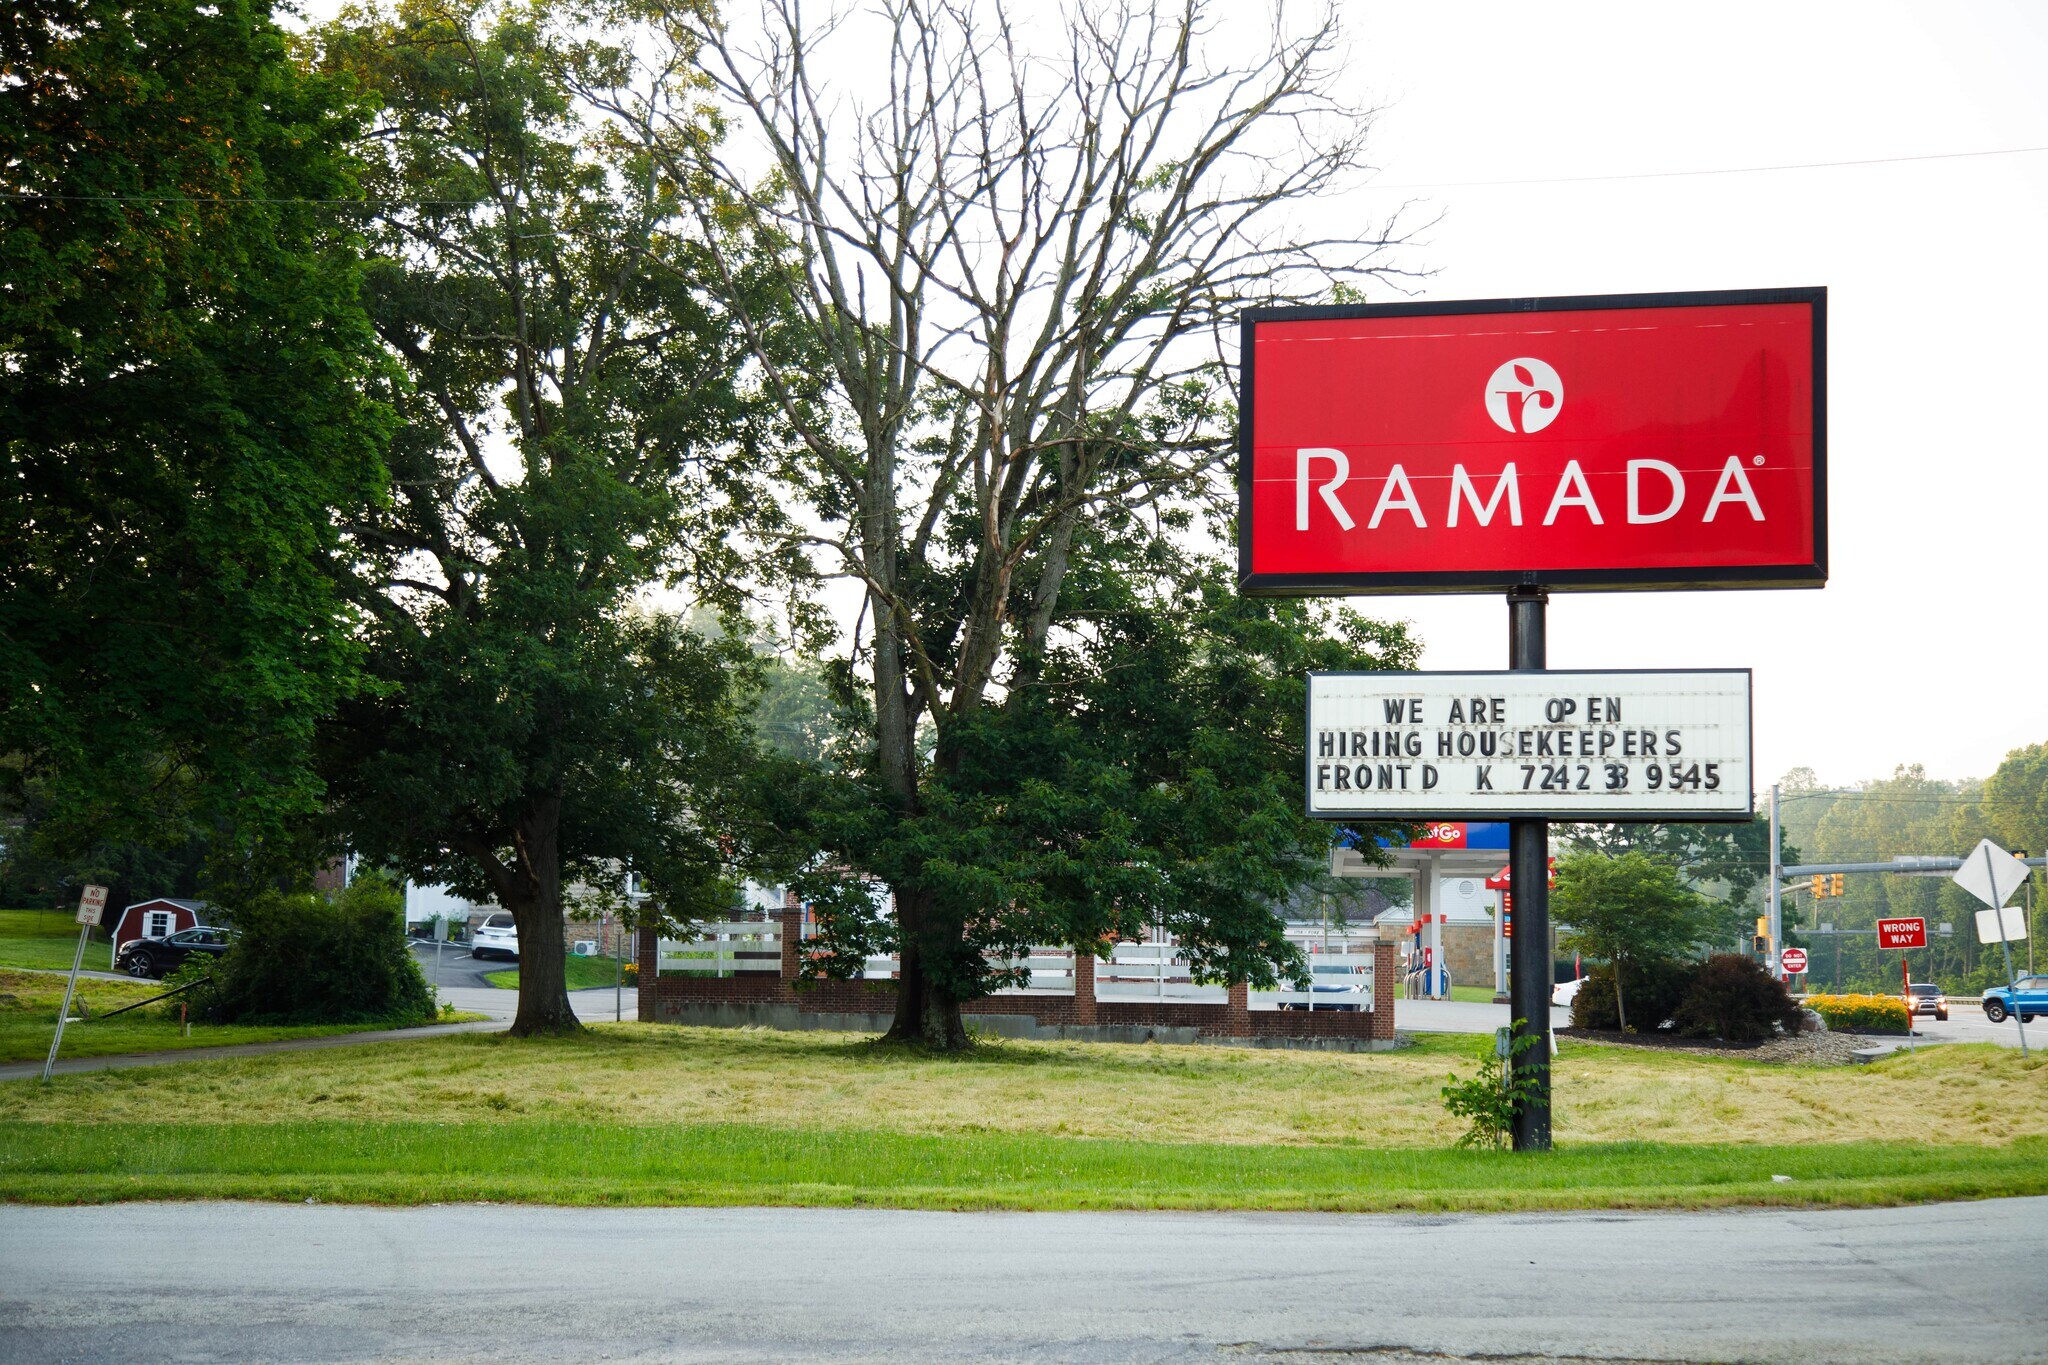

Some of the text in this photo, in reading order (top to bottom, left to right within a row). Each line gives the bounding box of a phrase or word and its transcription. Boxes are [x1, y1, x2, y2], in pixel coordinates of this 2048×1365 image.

[1383, 698, 1424, 724] WE
[1448, 698, 1505, 724] ARE
[1318, 729, 1682, 757] HIRING HOUSEKEEPERS
[1316, 764, 1412, 790] FRONT
[90, 889, 100, 897] NO
[83, 897, 104, 907] PARKING
[1882, 922, 1920, 933] WRONG
[1890, 934, 1914, 944] WAY
